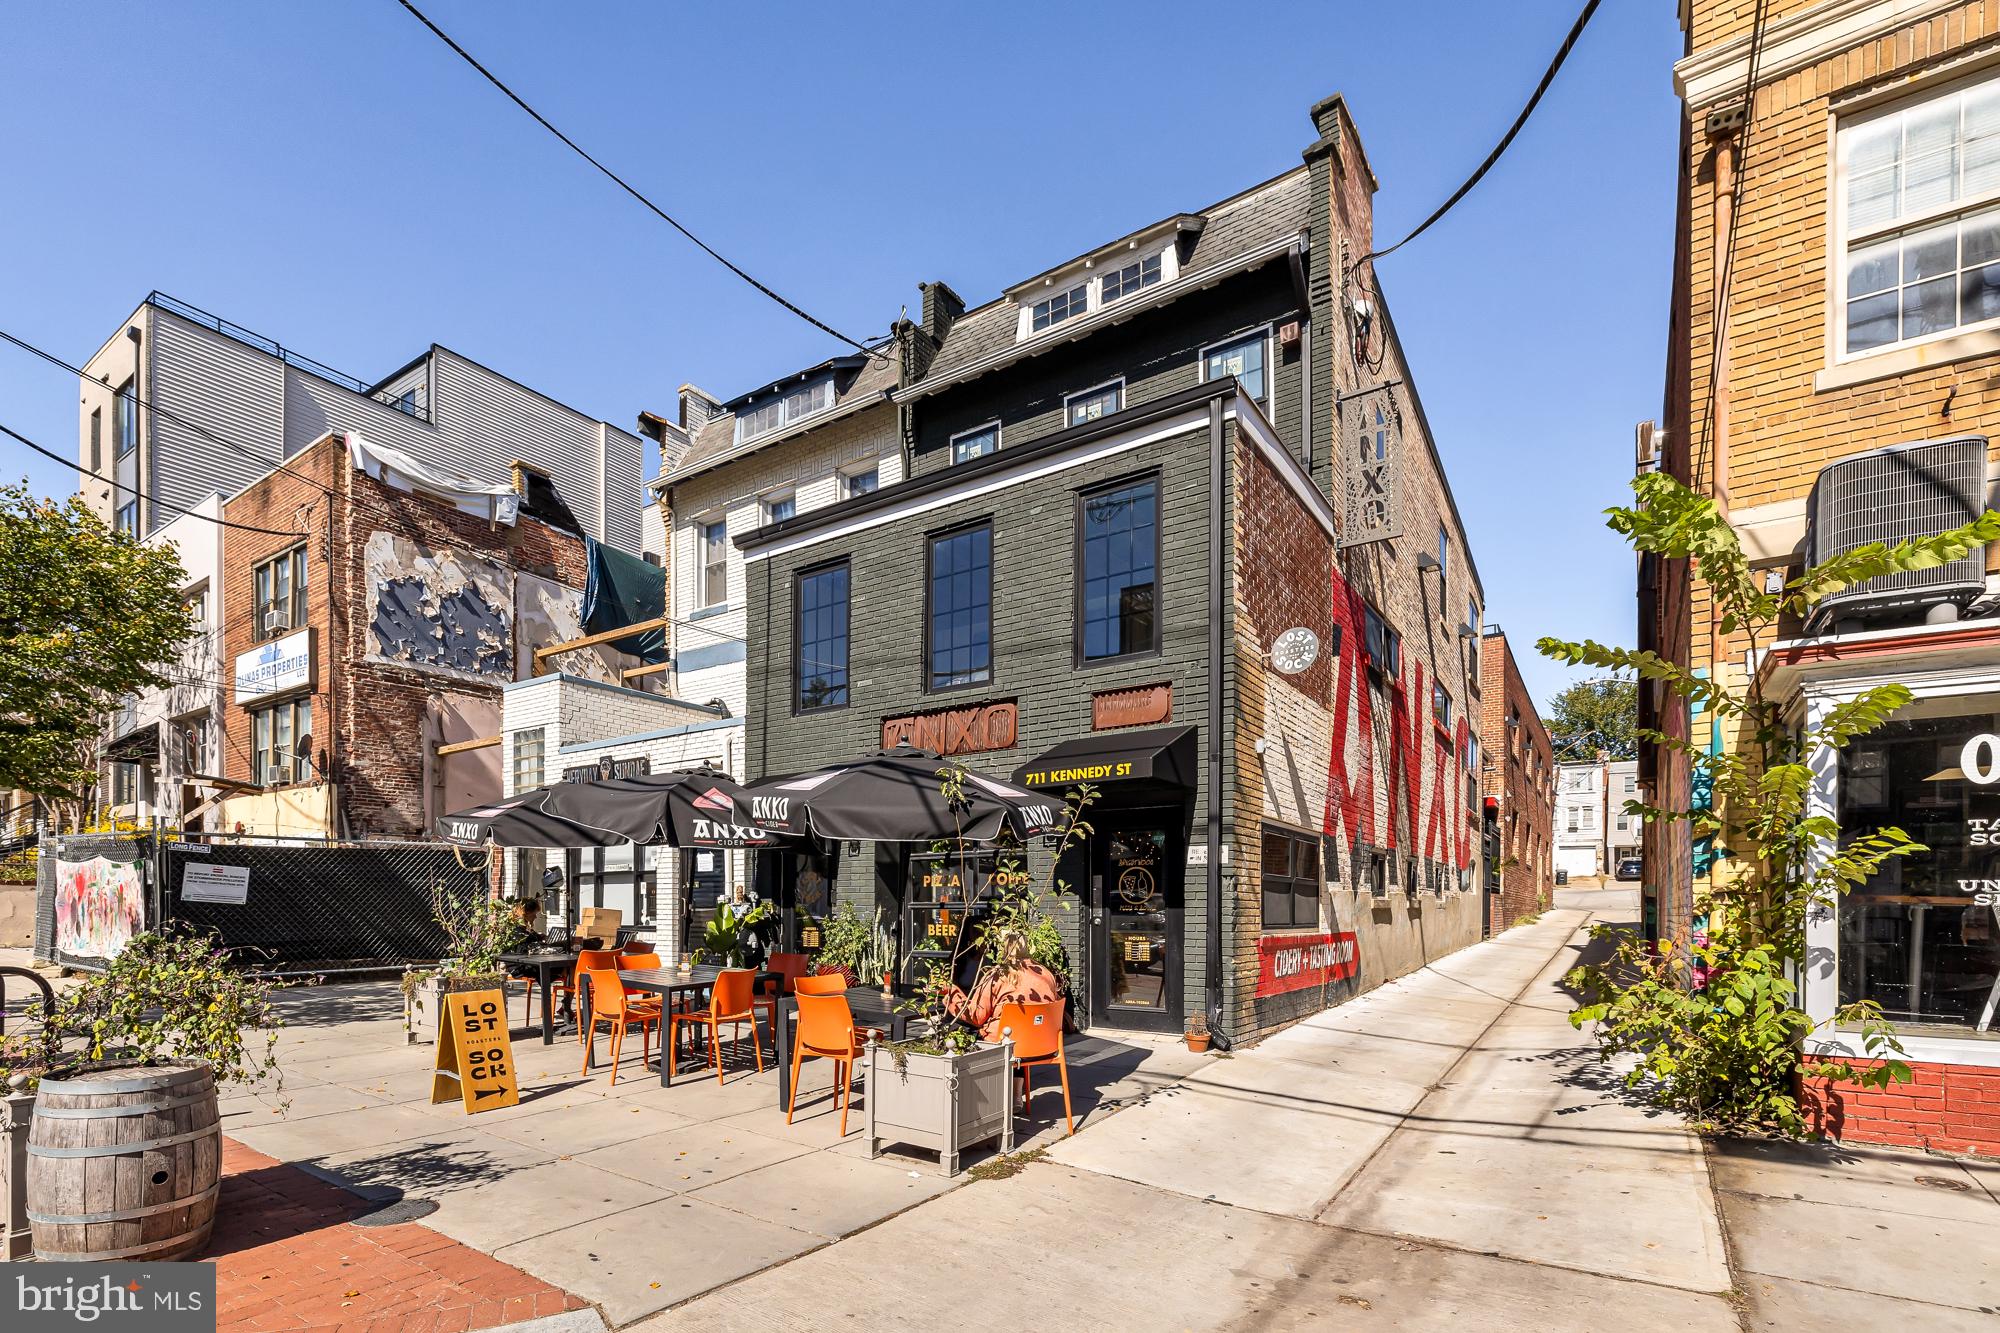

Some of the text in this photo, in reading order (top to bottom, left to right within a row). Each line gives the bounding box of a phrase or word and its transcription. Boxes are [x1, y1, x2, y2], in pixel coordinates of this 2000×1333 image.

[1277, 630, 1313, 649] LOST
[261, 653, 308, 679] PROPERTIES
[1275, 651, 1314, 670] SOCK
[884, 702, 1018, 756] ANXO
[1026, 763, 1132, 785] 711 KENNEDY ST
[751, 796, 790, 821] ANXO
[1018, 804, 1054, 829] ANXO
[450, 822, 479, 840] ANXO
[692, 819, 766, 840] ANXO
[170, 842, 209, 852] LONG FENCE
[923, 874, 961, 887] PIZA
[927, 923, 958, 937] BEER
[1274, 947, 1303, 978] CIDERY
[1309, 942, 1337, 970] TASTING
[1336, 940, 1354, 964] ROOM
[466, 1036, 501, 1045] ROASTERS
